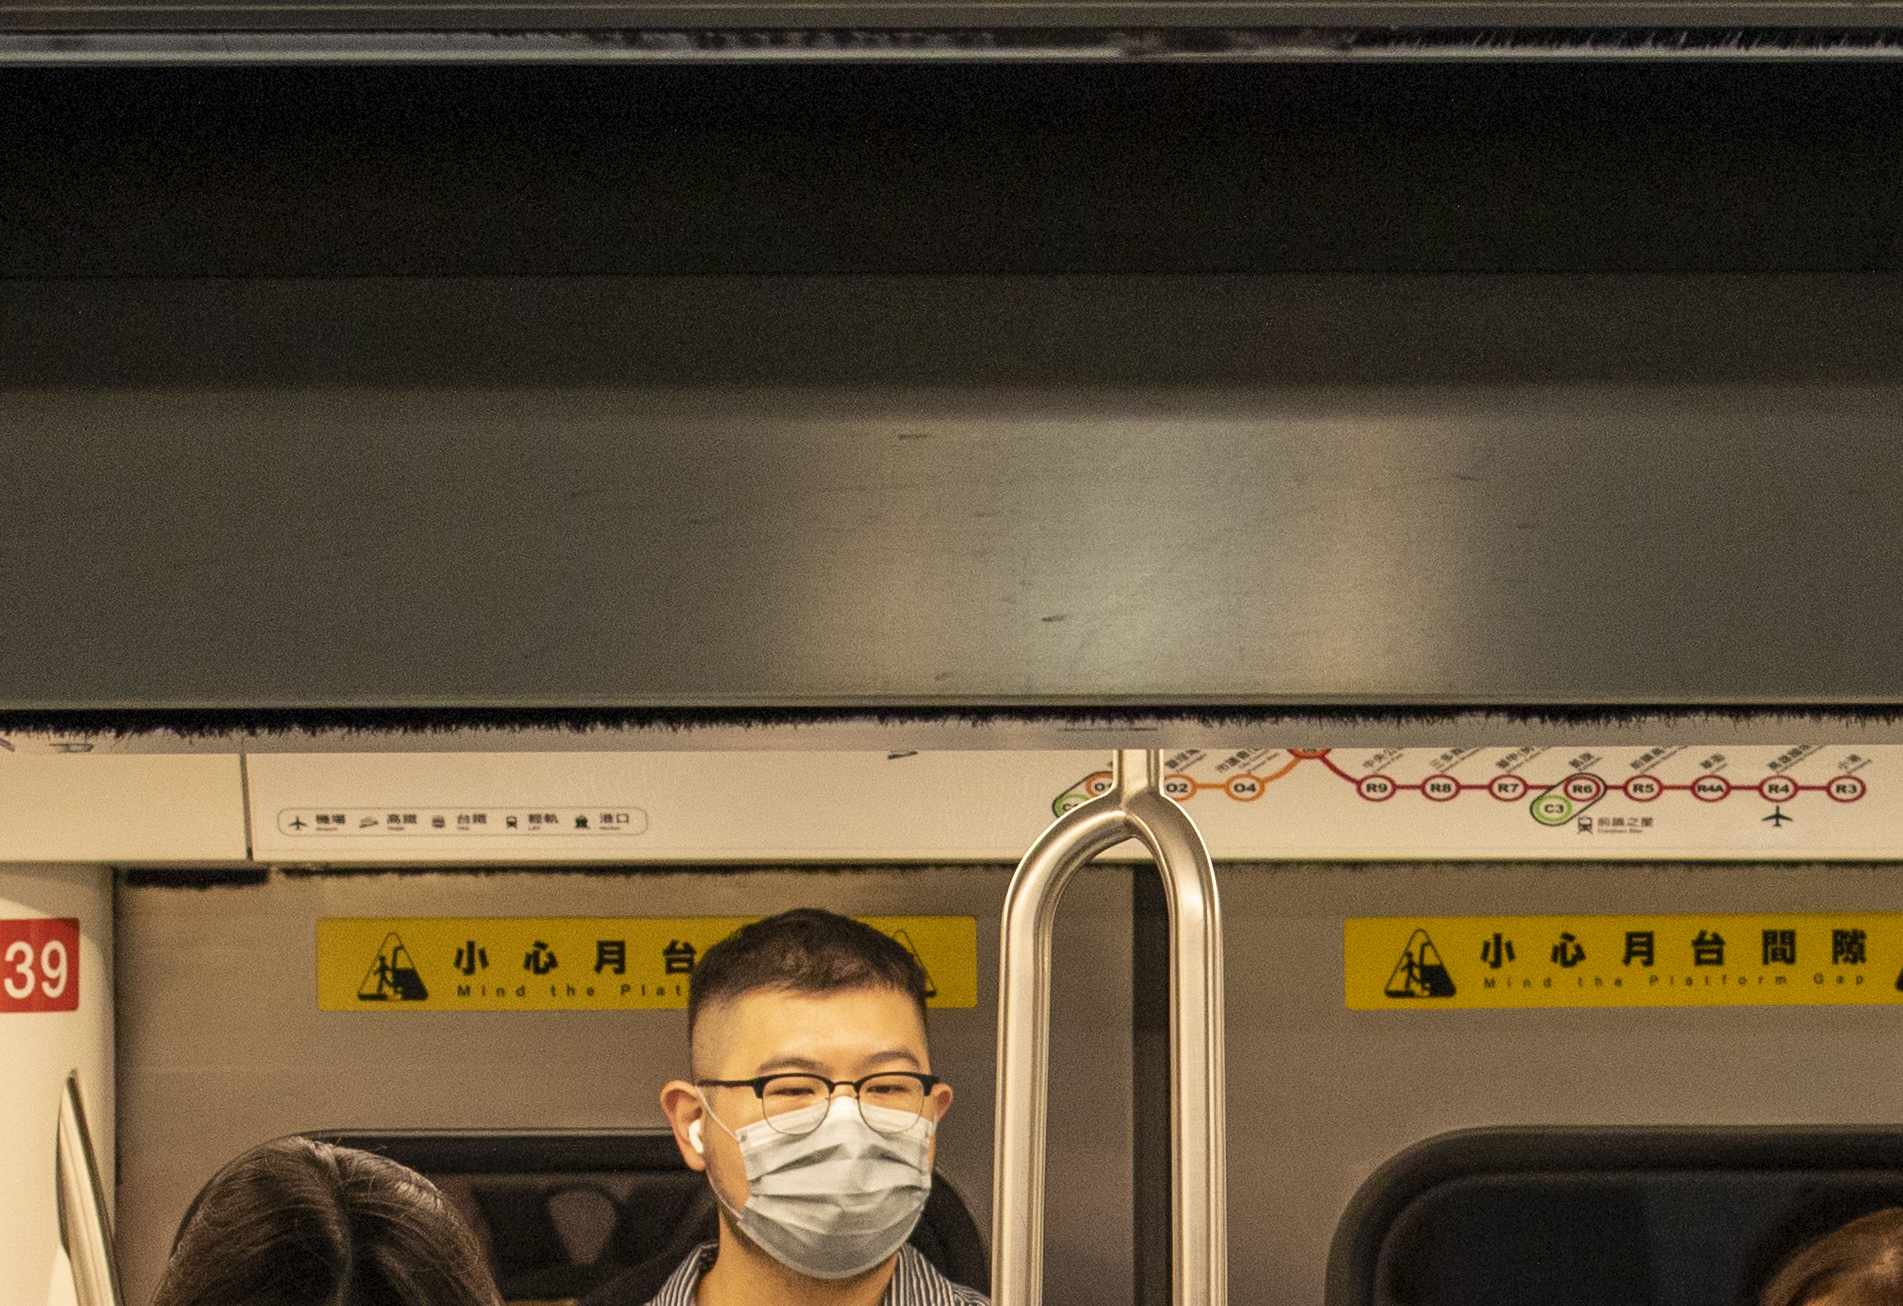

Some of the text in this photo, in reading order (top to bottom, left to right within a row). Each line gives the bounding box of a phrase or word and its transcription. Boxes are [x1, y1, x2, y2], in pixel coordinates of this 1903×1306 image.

[1165, 782, 1188, 793] O2
[1233, 782, 1257, 793] O4
[1365, 783, 1388, 793] R9
[1429, 783, 1452, 793] R8
[1497, 783, 1520, 793] R7
[1572, 784, 1593, 794] R6
[1632, 783, 1655, 793] R5
[1696, 784, 1724, 793] R4A
[1767, 783, 1790, 794] R4
[1835, 784, 1858, 794] R3
[1543, 803, 1564, 814] C3
[1480, 928, 1867, 969] 小心月台間隙
[1482, 972, 1866, 990] Mind the Platform Gap
[457, 984, 527, 997] Mind
[551, 984, 595, 997] the
